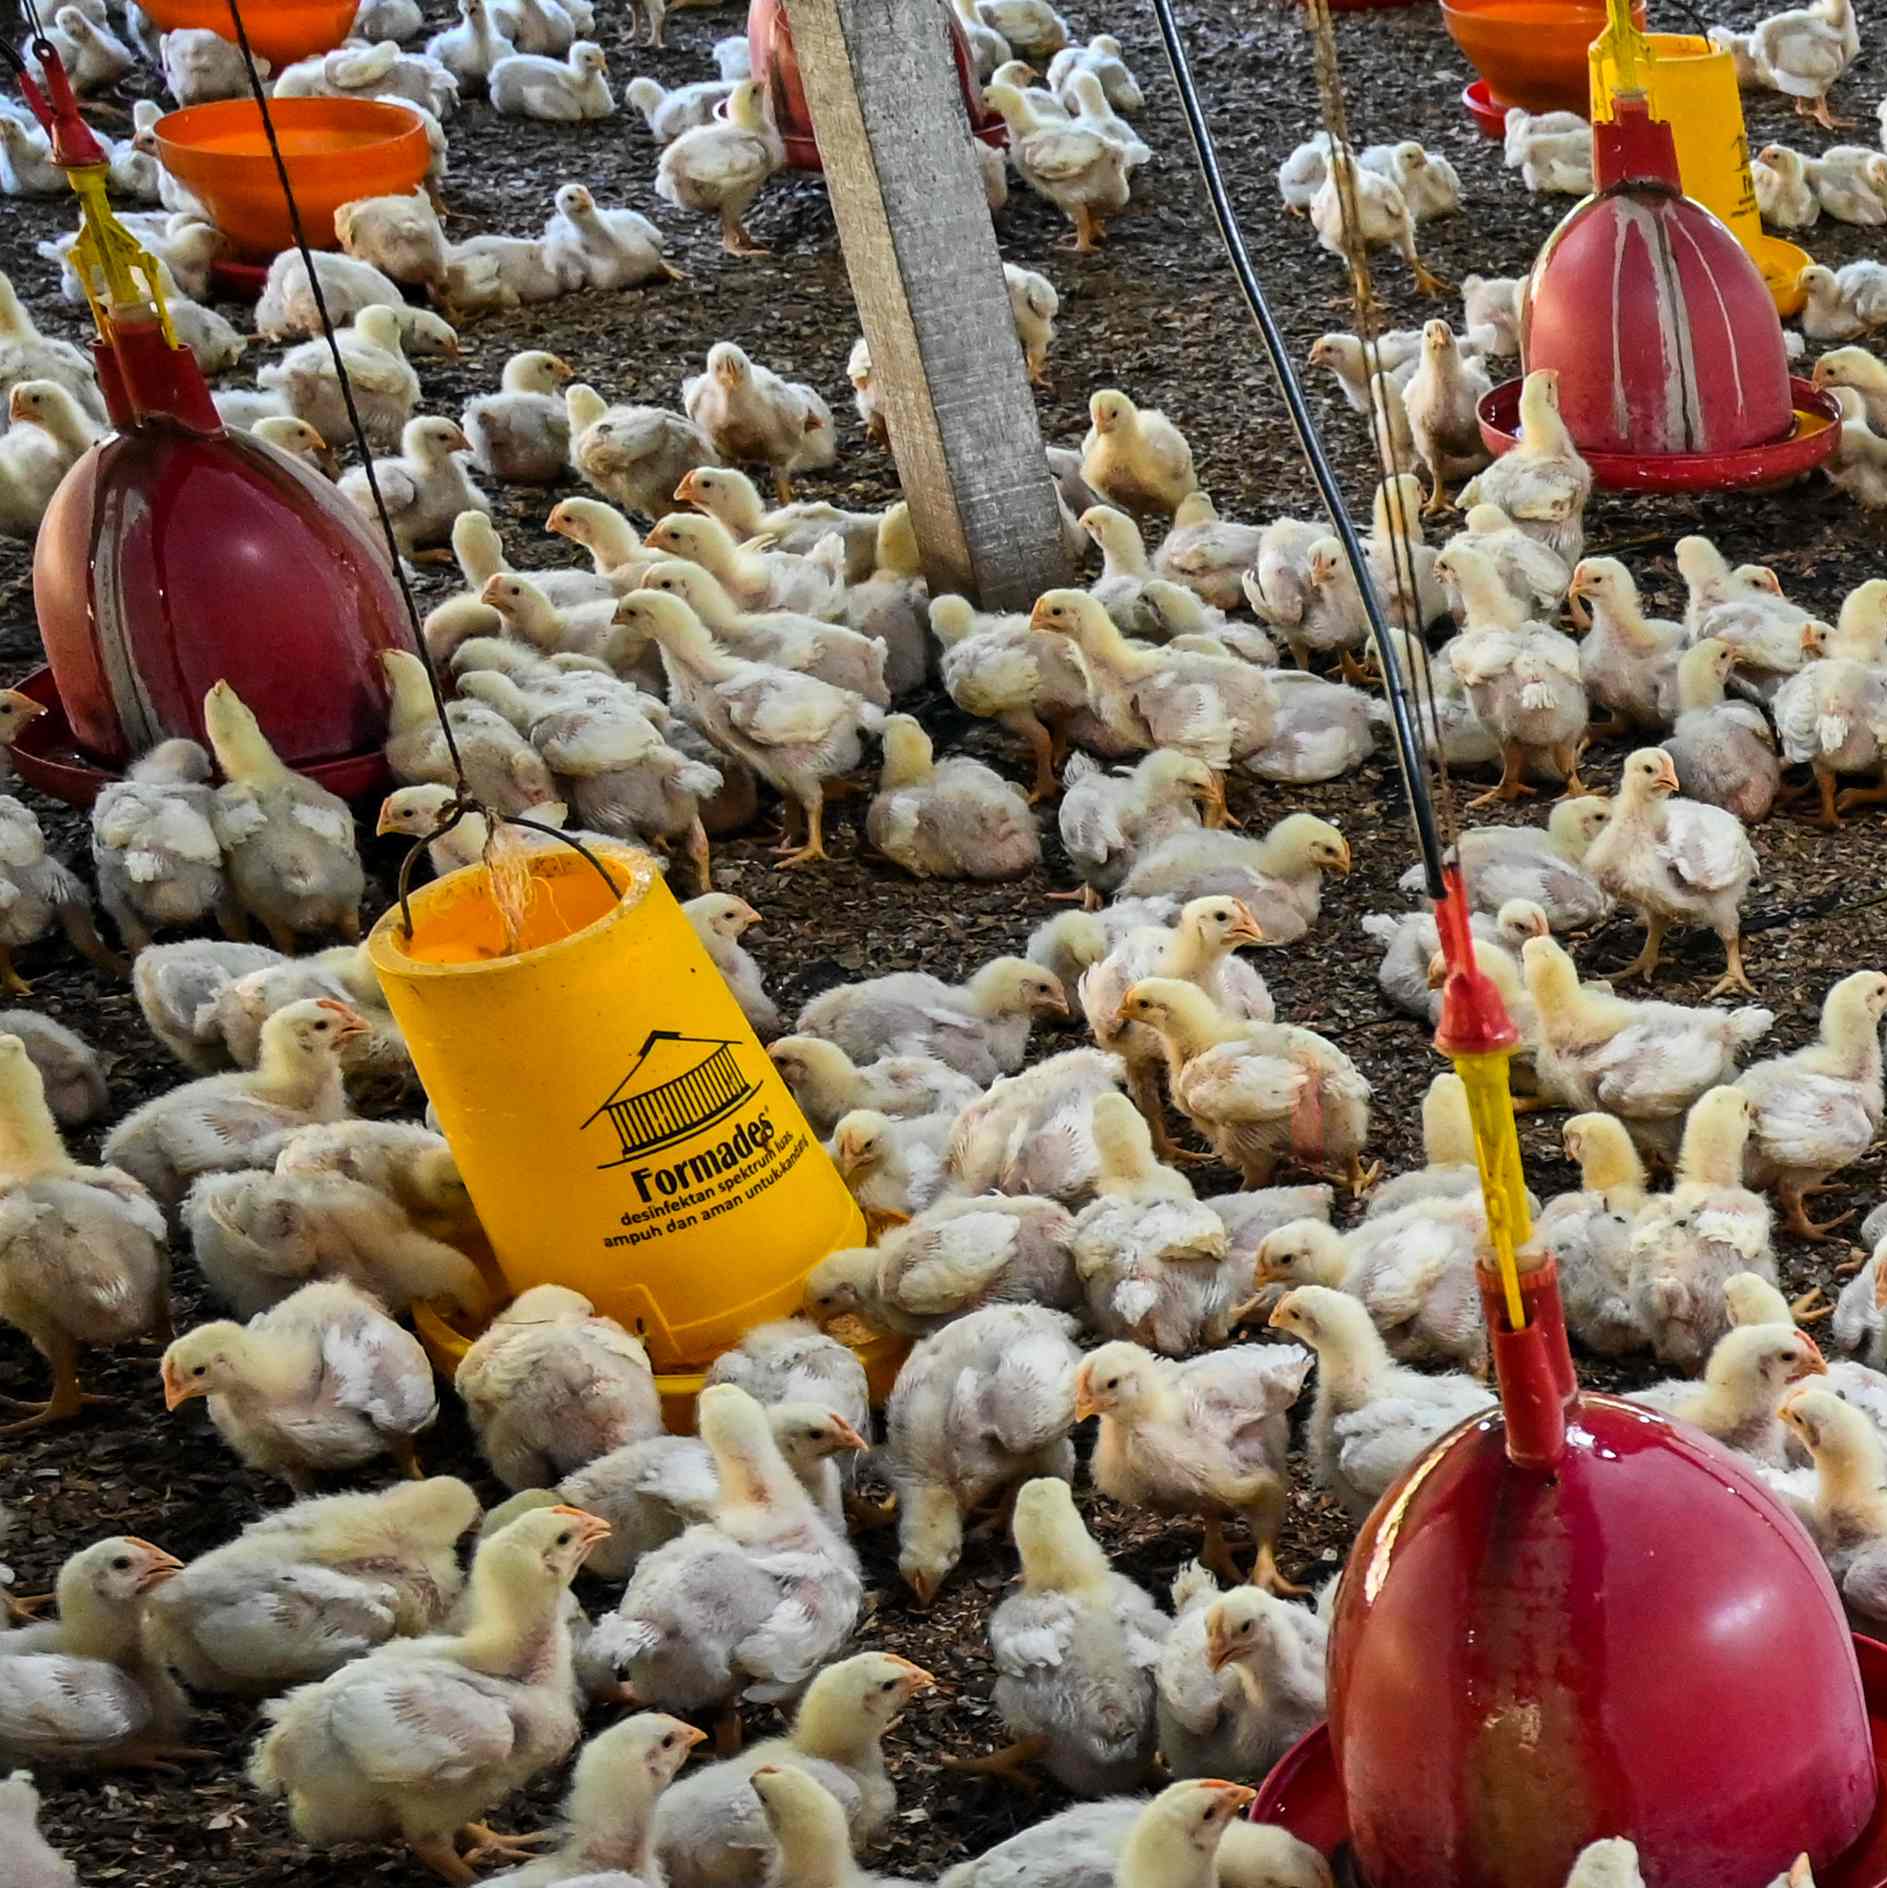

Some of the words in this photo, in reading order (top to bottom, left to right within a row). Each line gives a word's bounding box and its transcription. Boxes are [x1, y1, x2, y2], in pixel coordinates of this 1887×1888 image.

[620, 1186, 716, 1227] desinfektan
[718, 1146, 778, 1193] spektrum
[631, 1112, 774, 1203] Formades
[604, 1225, 663, 1249] ampuh
[666, 1214, 698, 1234] dan
[702, 1194, 744, 1222] aman
[744, 1167, 784, 1200] untuk
